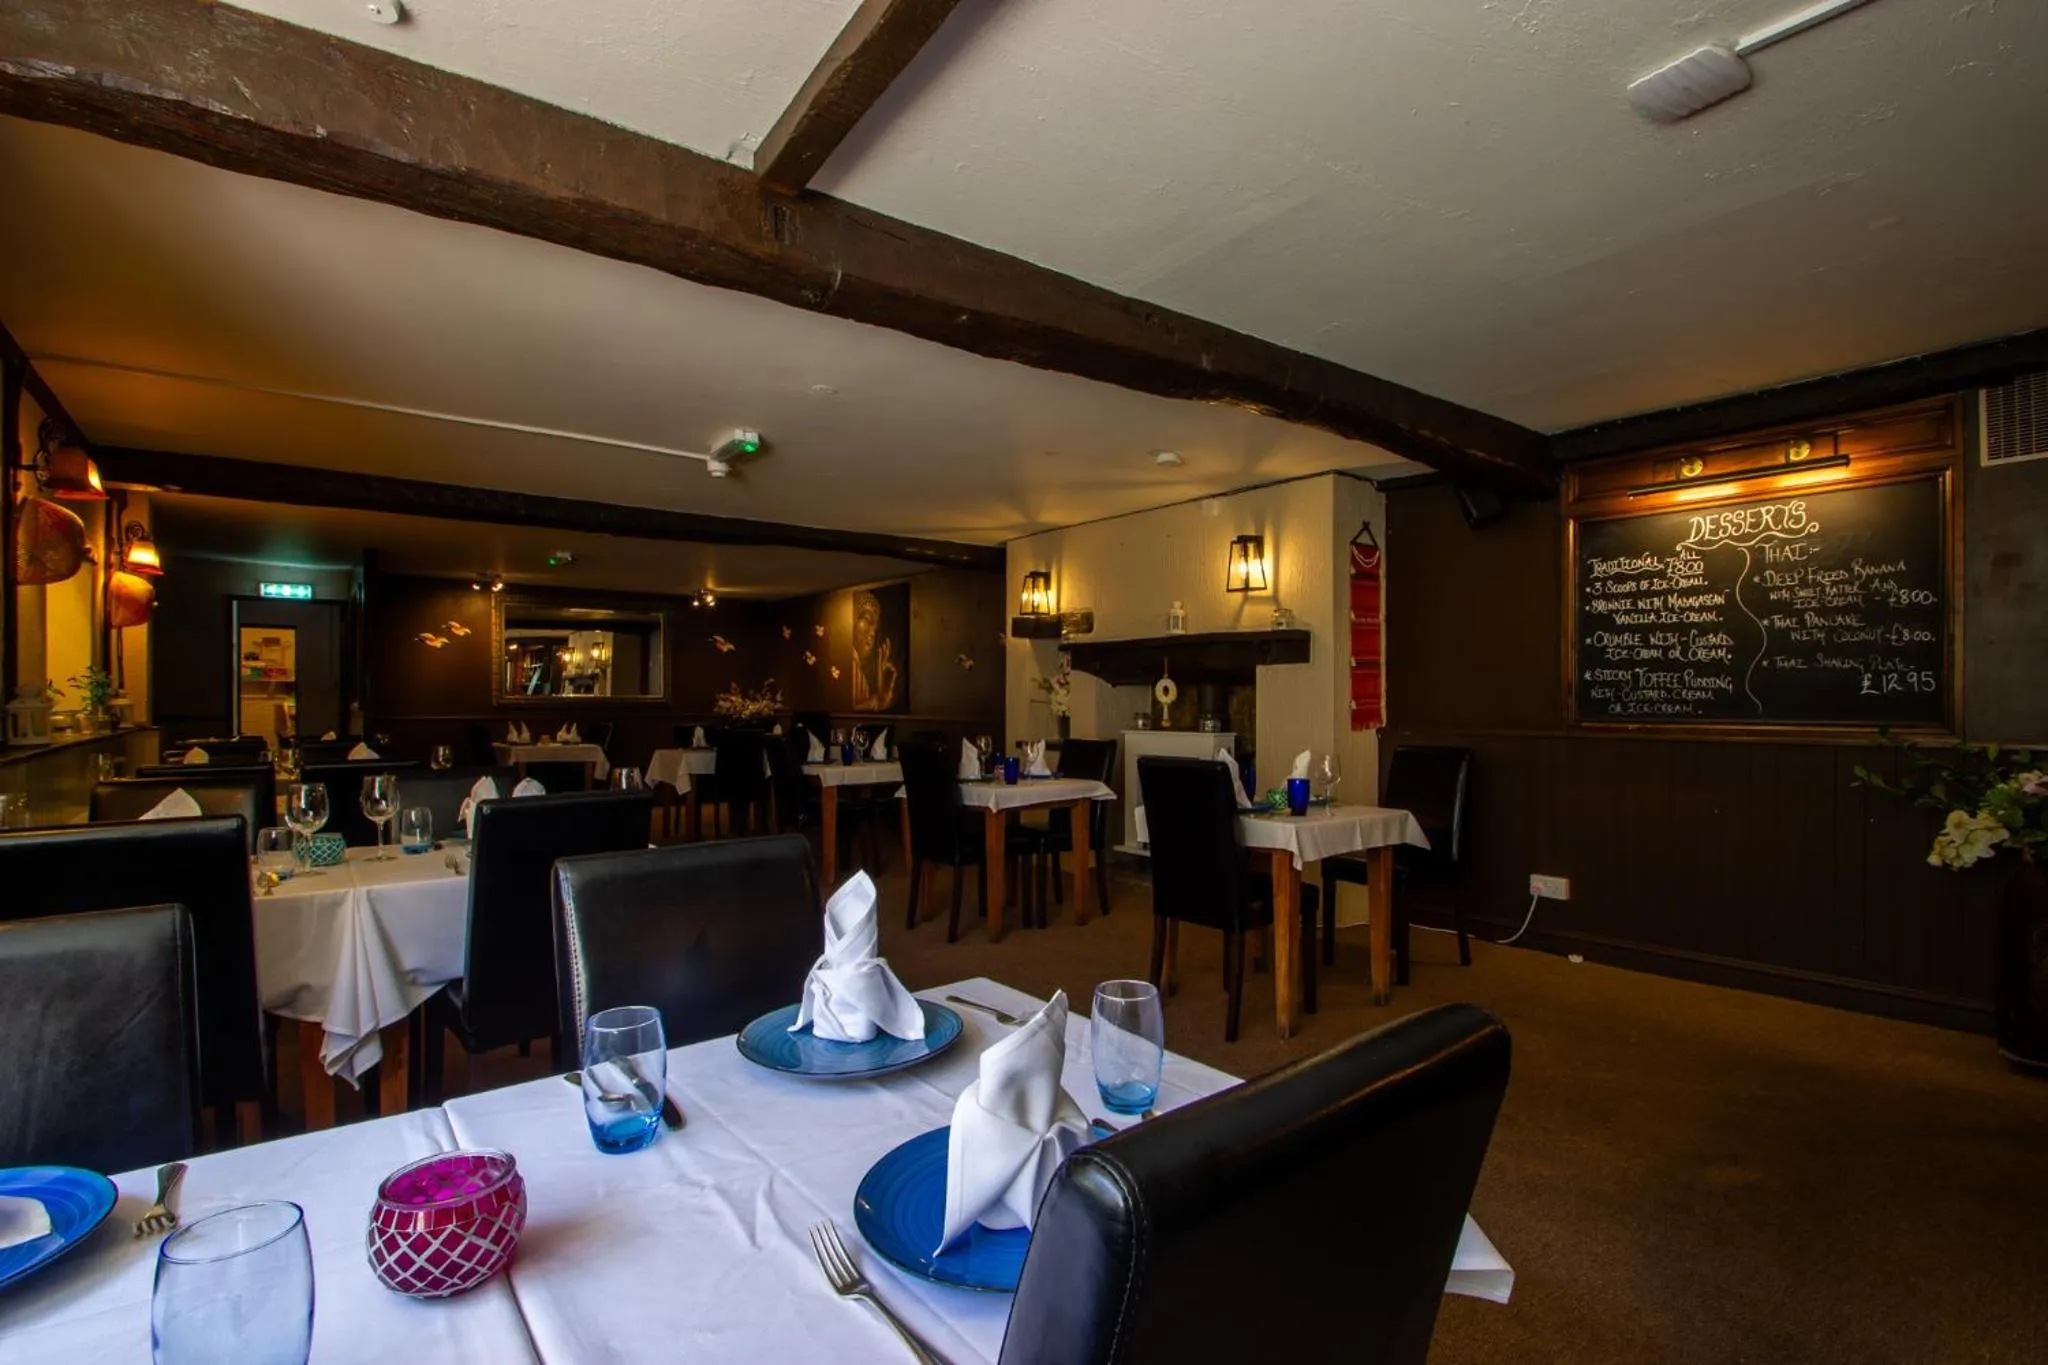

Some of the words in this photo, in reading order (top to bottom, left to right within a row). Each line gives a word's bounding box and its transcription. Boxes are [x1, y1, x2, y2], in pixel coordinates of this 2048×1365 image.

[1685, 500, 1806, 542] DESSERTS
[1680, 549, 1701, 560] ALL
[1762, 571, 1804, 586] DEEP
[1809, 567, 1848, 584] FRIED
[1851, 558, 1906, 581] BANANA
[1592, 583, 1602, 594] 3
[1607, 581, 1636, 593] SCOOPS
[1640, 581, 1651, 590] OF
[1770, 592, 1790, 601] WITH
[1791, 586, 1820, 600] SWEET
[1825, 584, 1866, 594] BATTER
[1869, 579, 1898, 592] AND
[1592, 599, 1635, 613] BROWNIE
[1638, 598, 1665, 610] WITH
[1612, 613, 1659, 624] VANILLA
[1771, 615, 1800, 629] THAI
[1805, 611, 1865, 628] PANCAKE
[1593, 631, 1644, 647] CRUMBLE
[1649, 631, 1679, 645] WITH
[1690, 630, 1734, 647] CUSTARD
[1791, 631, 1825, 645] WITH
[1834, 629, 1884, 643] COCONUT
[1670, 646, 1686, 661] OR
[1774, 656, 1808, 669] THAI
[1595, 669, 1632, 687] STICKY
[1635, 668, 1682, 689] TOFFEE
[1684, 669, 1733, 694] PUDDING
[1591, 688, 1615, 699] WITH
[1673, 690, 1714, 700] CREAM
[1608, 704, 1622, 714] OR
